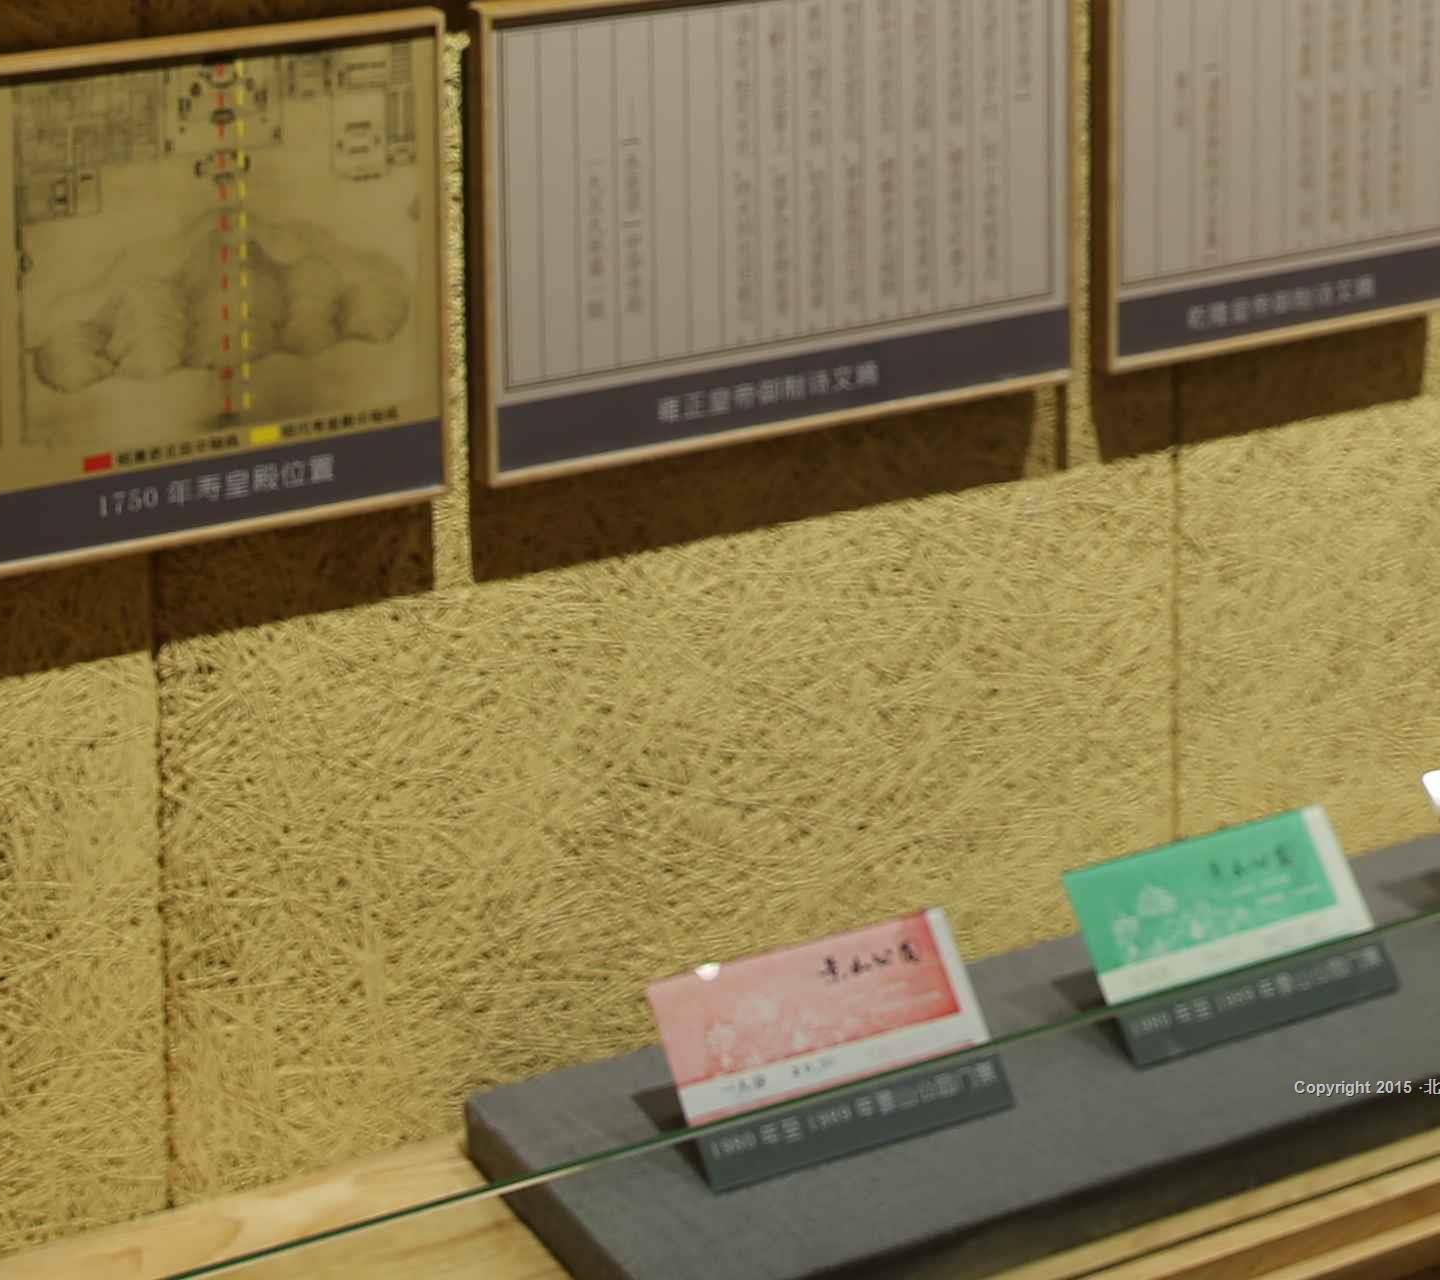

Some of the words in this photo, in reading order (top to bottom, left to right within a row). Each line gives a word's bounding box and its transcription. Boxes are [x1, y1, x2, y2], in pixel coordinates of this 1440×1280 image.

[98, 485, 160, 519] 1750
[166, 452, 335, 506] 年寿皇殿位置
